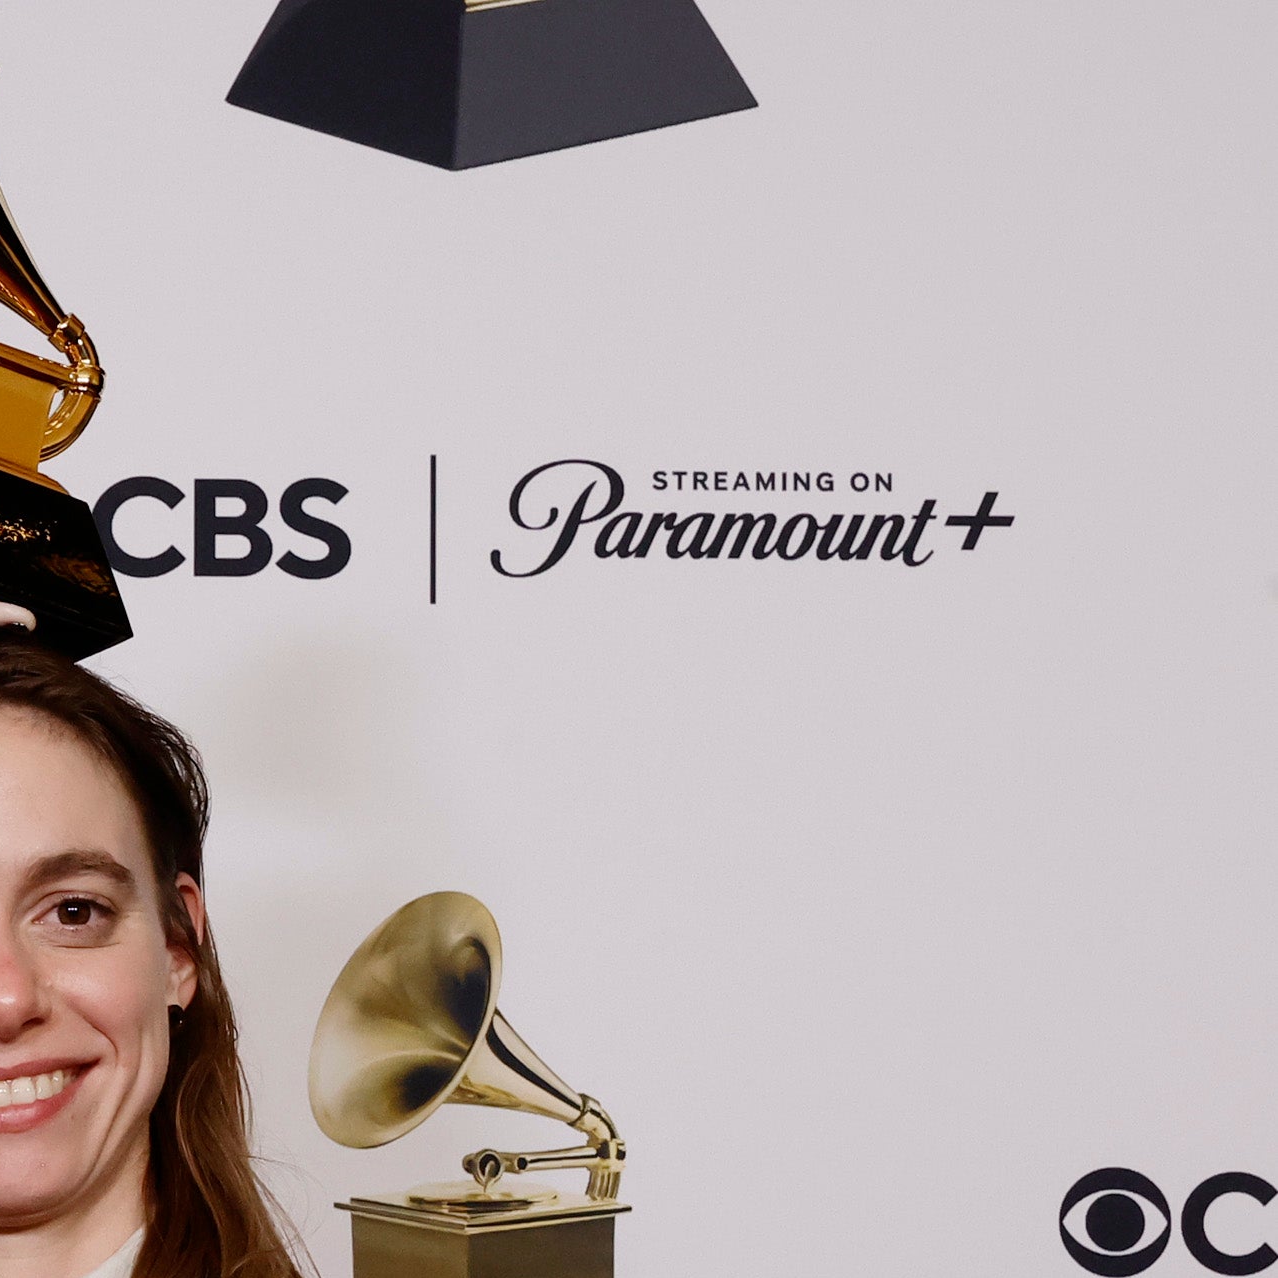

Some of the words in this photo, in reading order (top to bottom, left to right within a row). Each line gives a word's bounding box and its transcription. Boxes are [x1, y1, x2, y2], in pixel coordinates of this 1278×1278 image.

[92, 476, 352, 580] CBS
[490, 459, 1015, 578] Paramount+
[652, 470, 834, 492] STREAMING
[850, 472, 892, 493] ON
